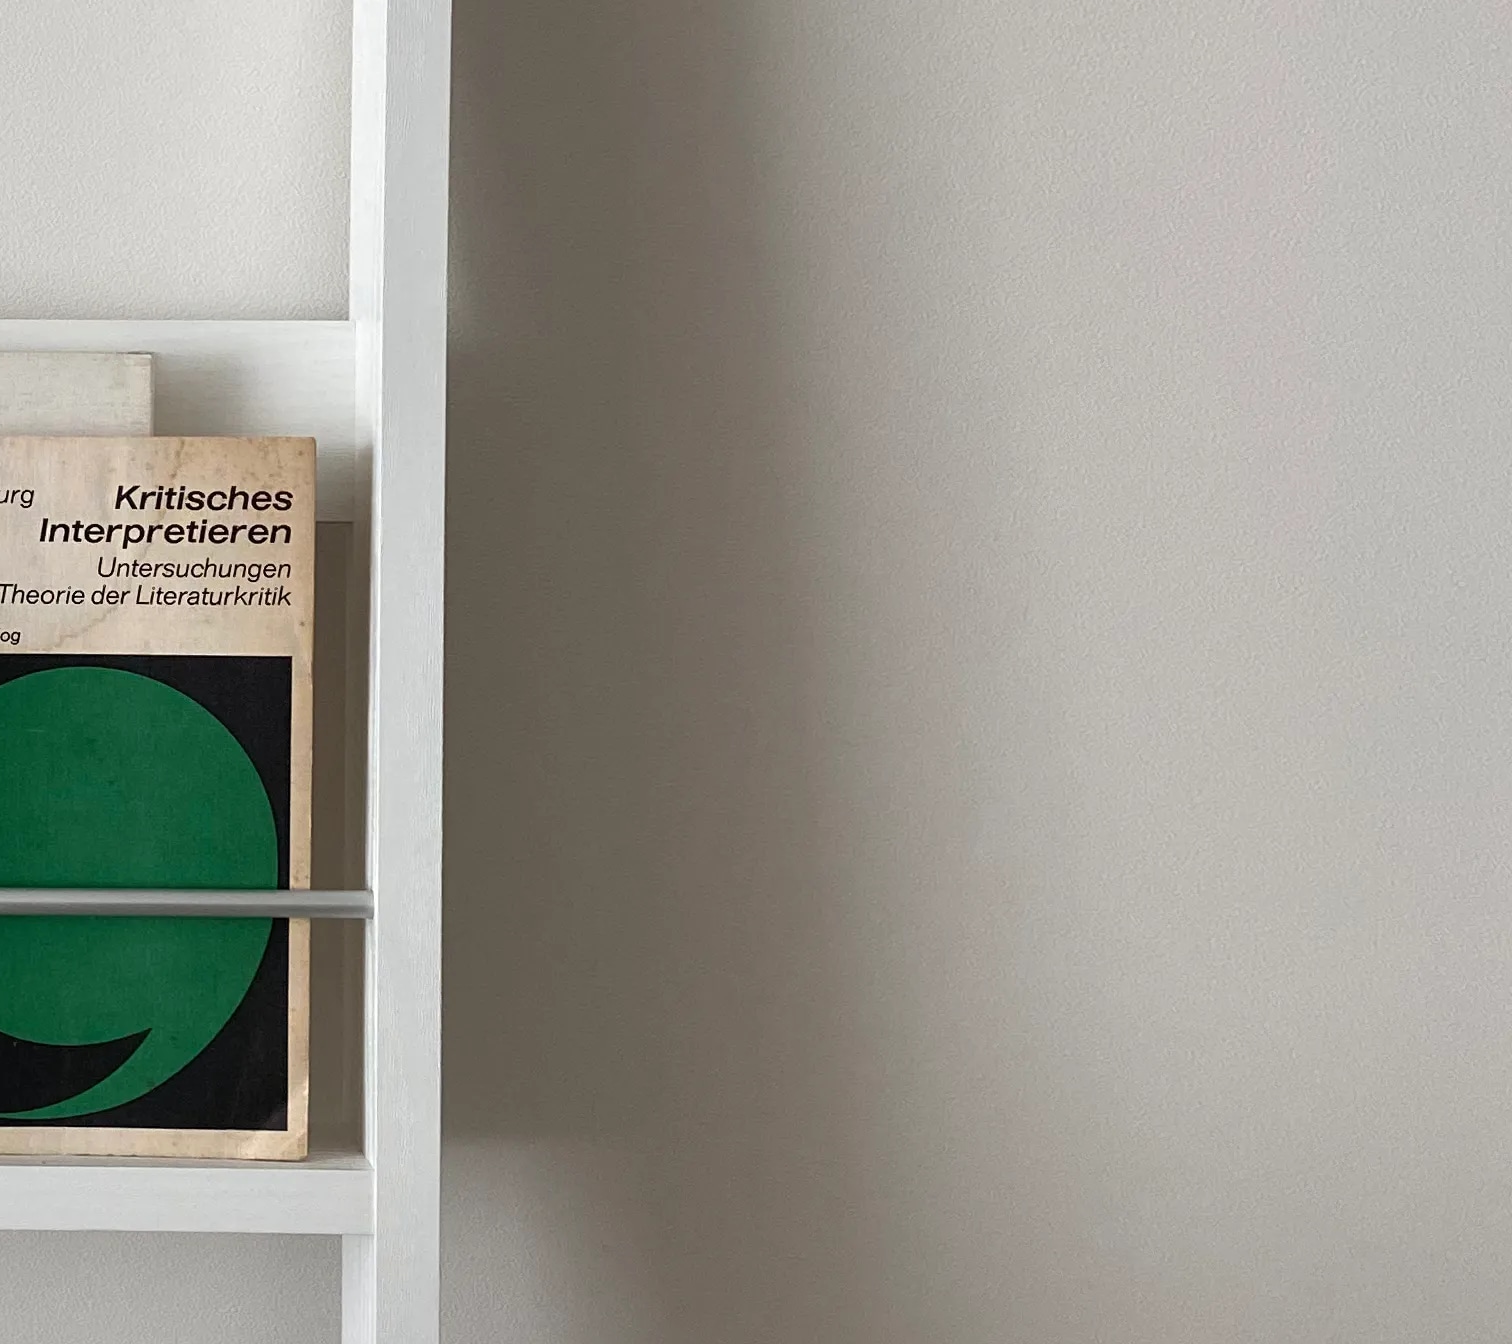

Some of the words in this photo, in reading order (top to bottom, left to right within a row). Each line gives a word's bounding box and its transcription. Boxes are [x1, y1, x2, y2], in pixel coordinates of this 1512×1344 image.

[115, 486, 293, 510] Kritisches
[40, 518, 292, 549] Interpretieren
[97, 557, 292, 582] Untersuchungen
[91, 585, 130, 604] der
[135, 584, 292, 606] Literaturkritik
